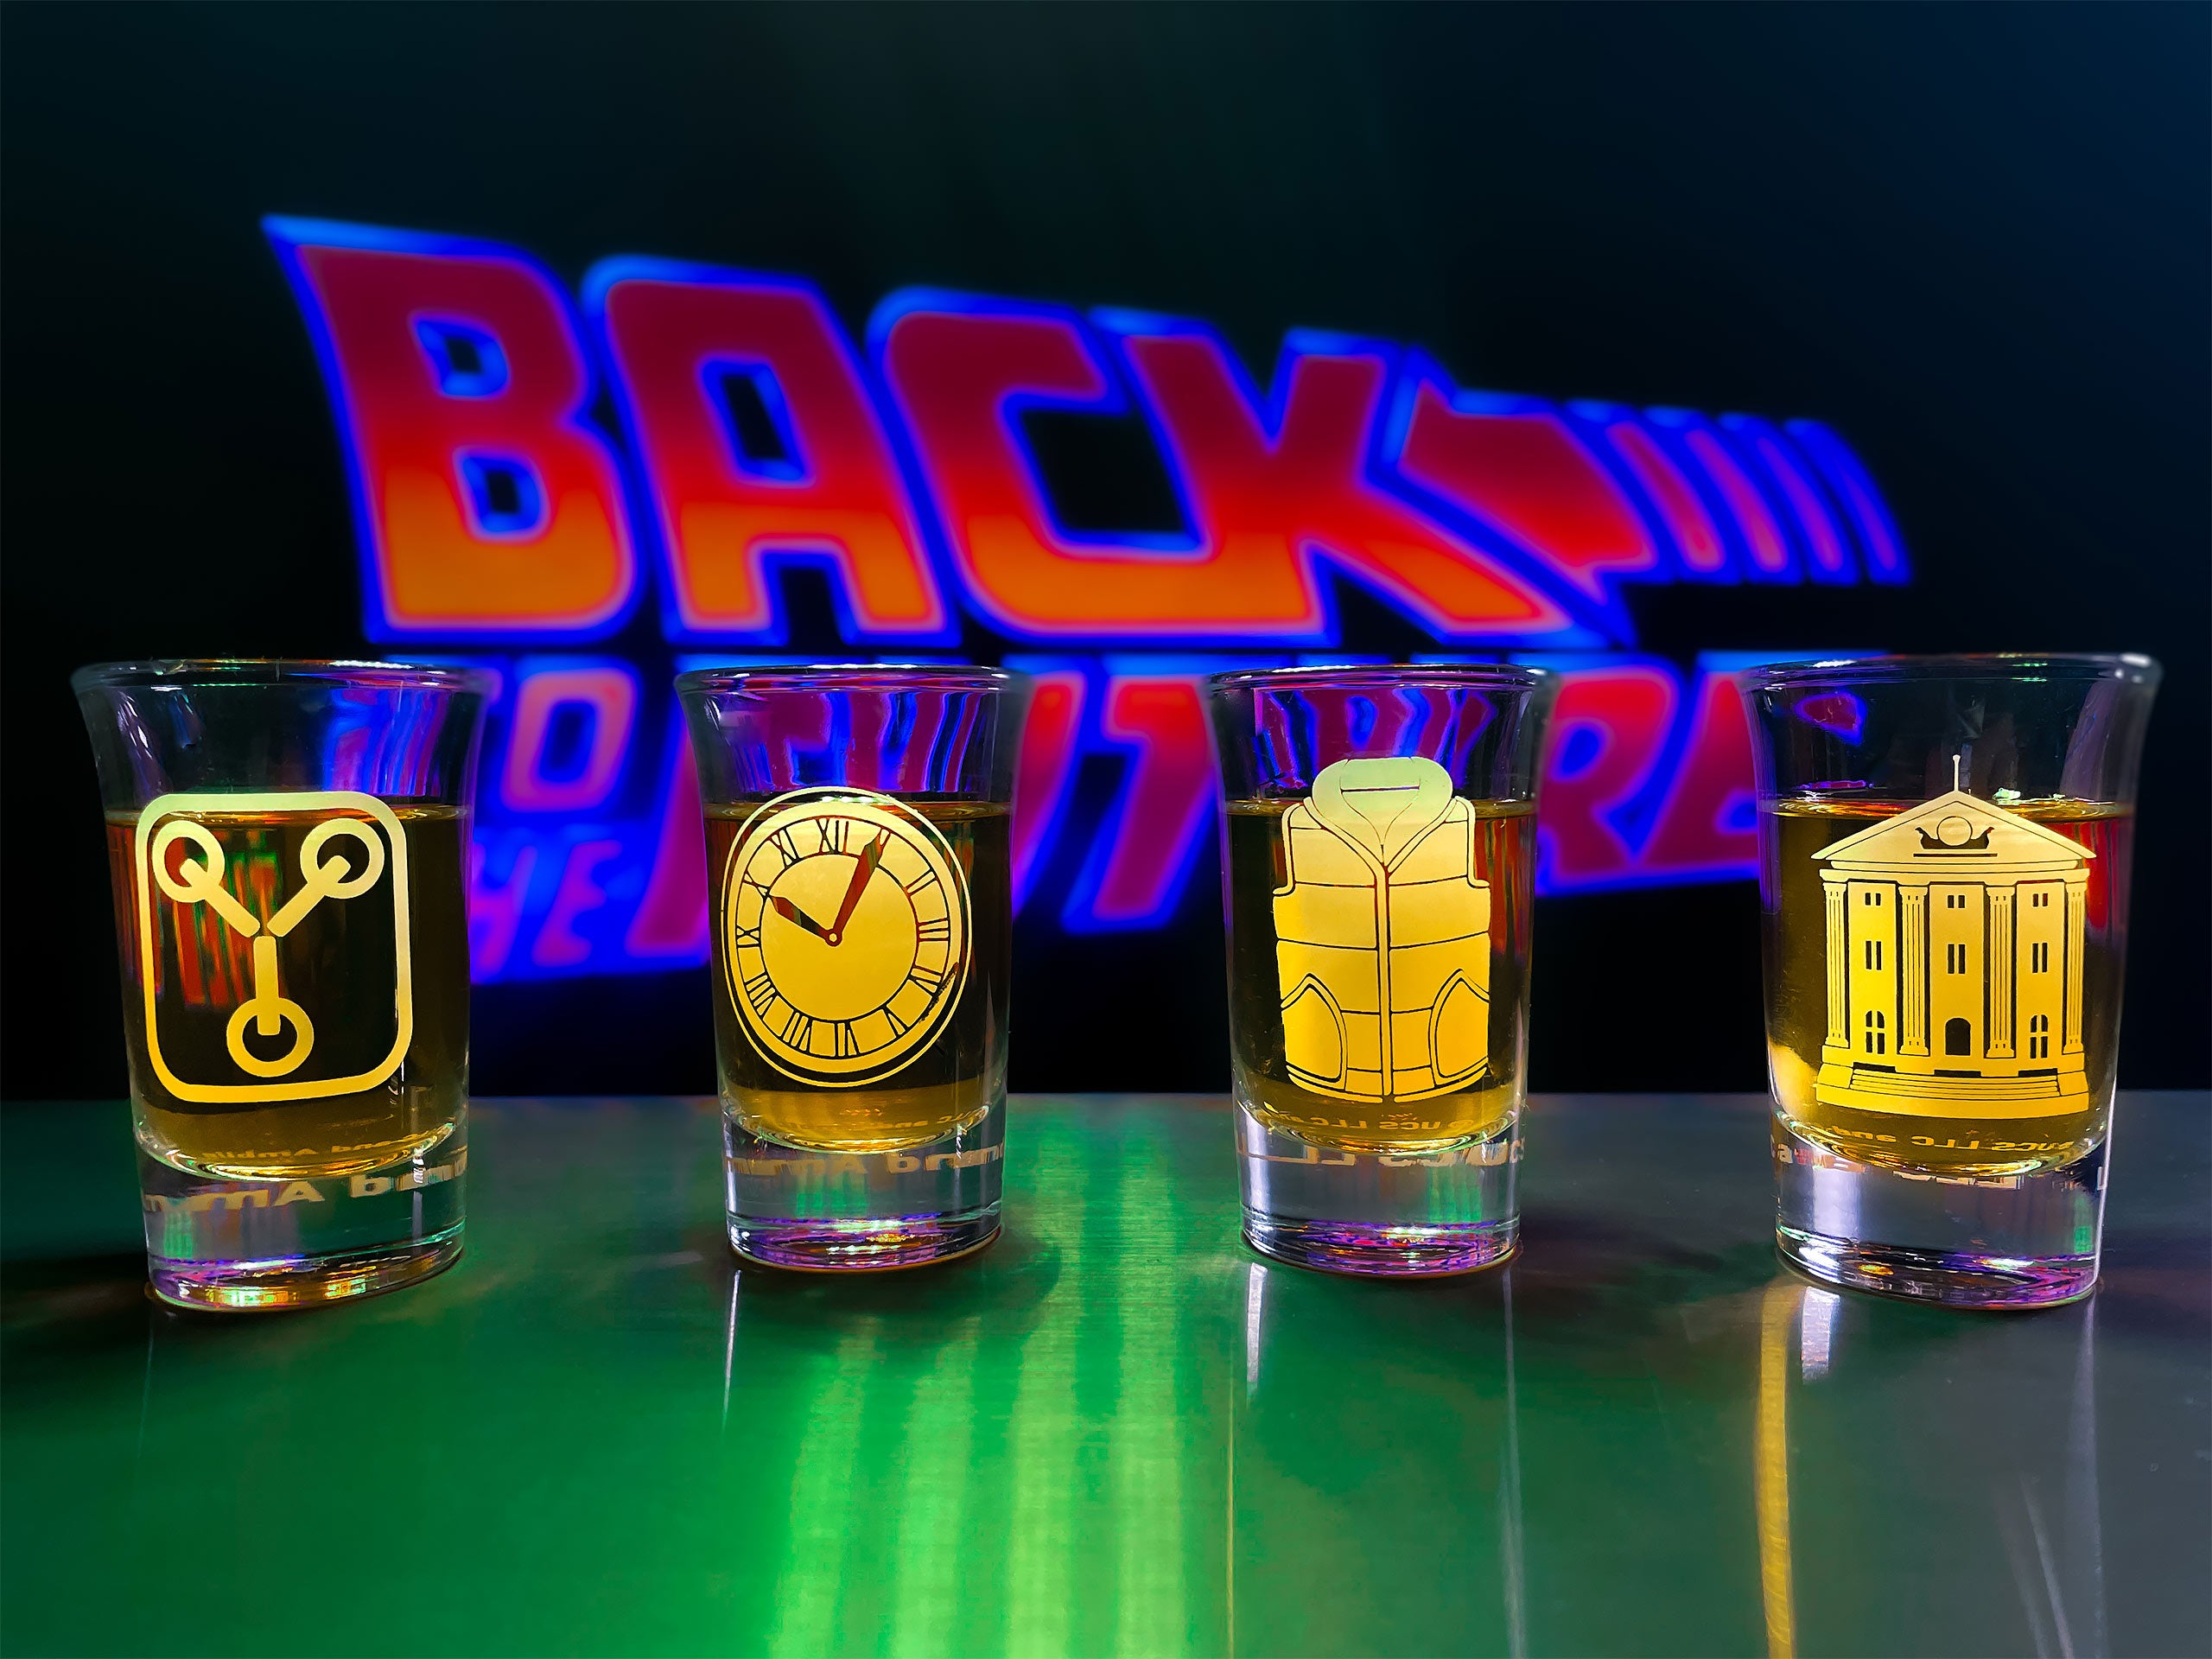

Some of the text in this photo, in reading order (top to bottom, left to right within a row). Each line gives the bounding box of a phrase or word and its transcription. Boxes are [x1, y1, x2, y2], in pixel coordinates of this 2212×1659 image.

[262, 214, 1629, 646] BACK
[471, 830, 629, 972] HE
[816, 818, 849, 855] XII
